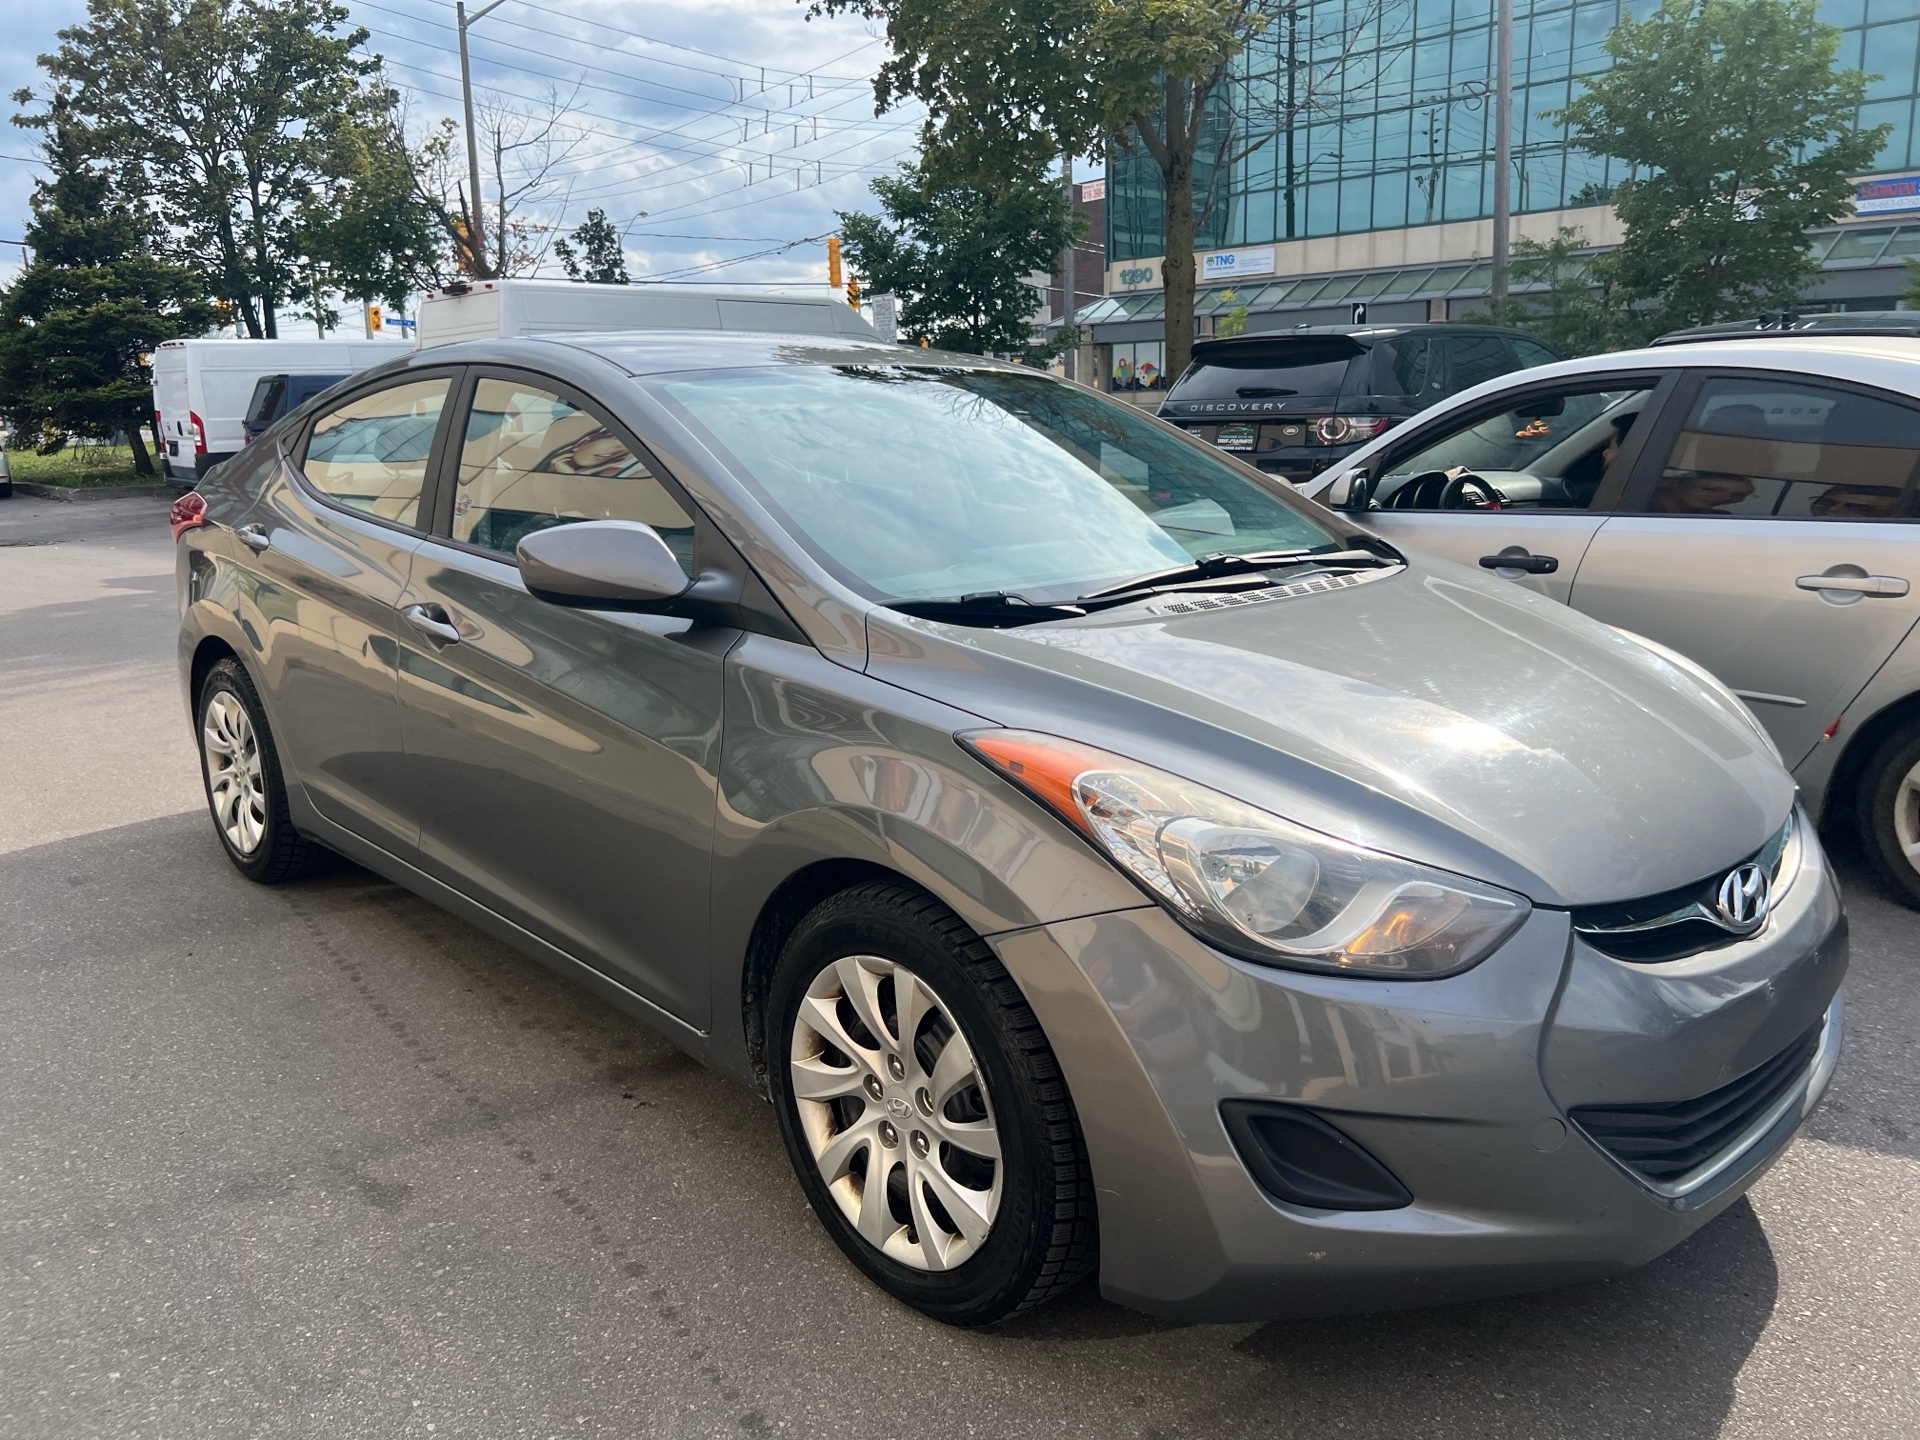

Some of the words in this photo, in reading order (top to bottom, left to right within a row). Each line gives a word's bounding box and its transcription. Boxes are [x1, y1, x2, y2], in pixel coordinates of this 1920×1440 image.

[1215, 254, 1235, 266] TNG
[1120, 267, 1153, 285] 1280
[1190, 403, 1286, 412] DISCOVERY
